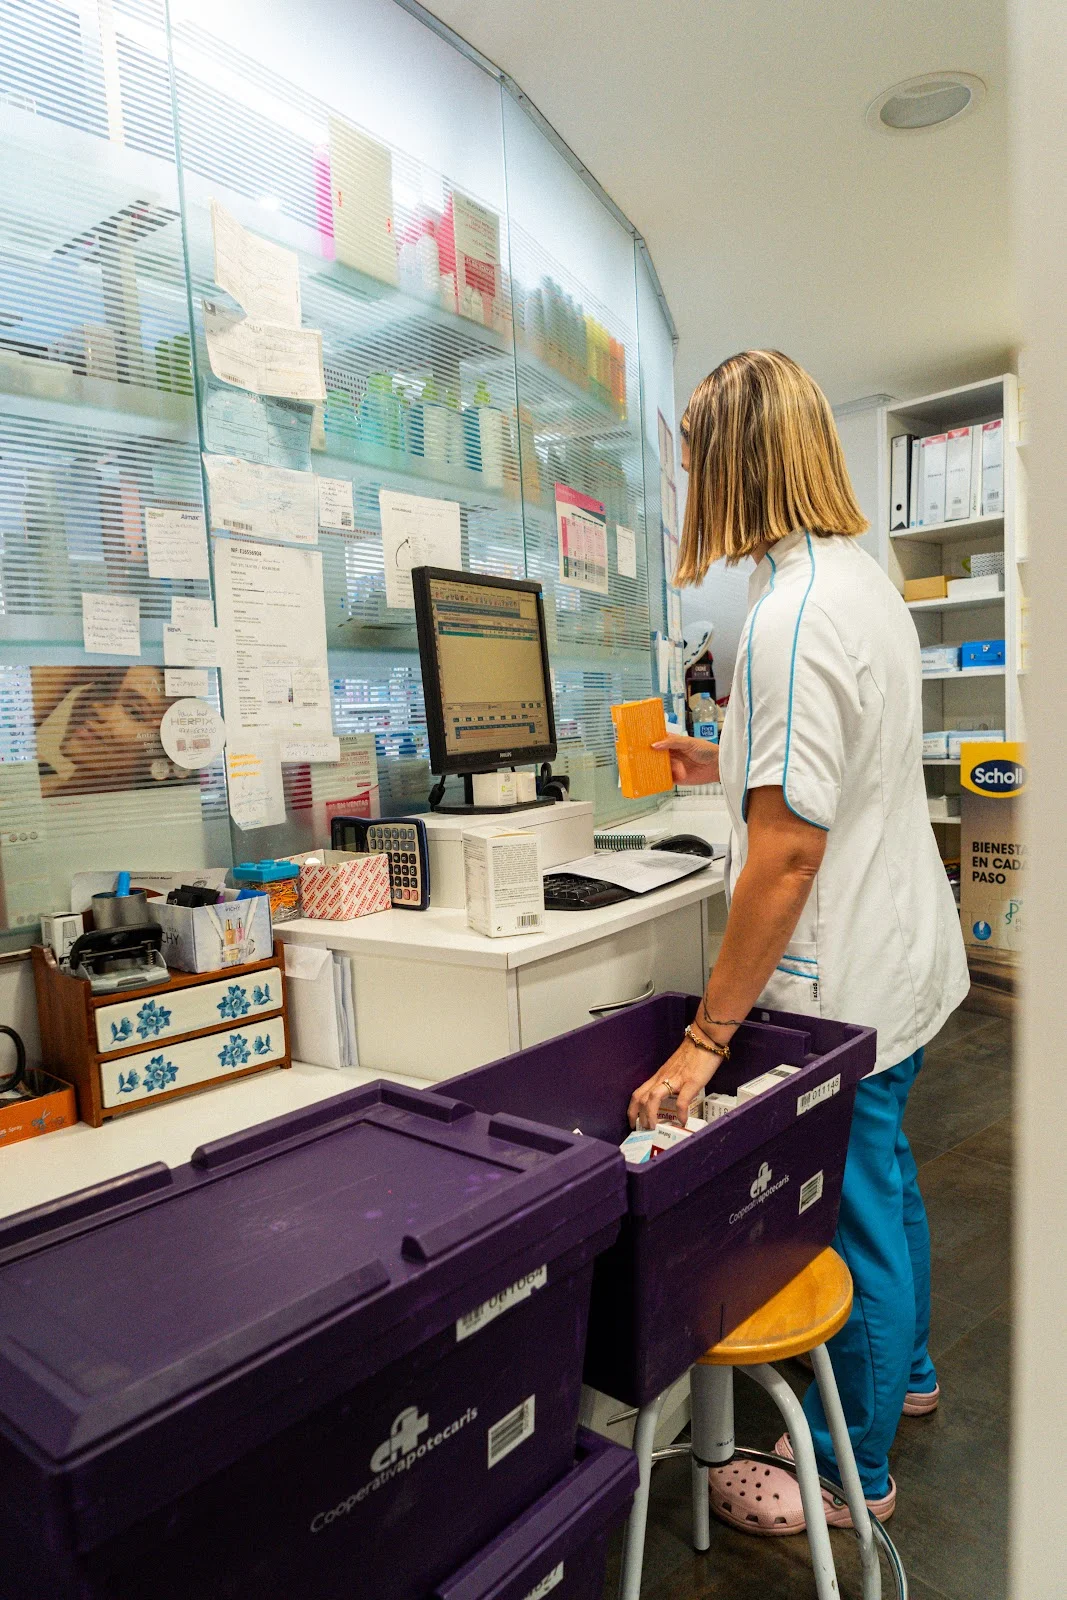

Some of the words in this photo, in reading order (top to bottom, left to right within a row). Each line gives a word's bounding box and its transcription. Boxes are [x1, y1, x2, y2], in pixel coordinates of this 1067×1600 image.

[170, 718, 213, 726] HERPIX
[974, 768, 1023, 784] Scholl
[972, 856, 988, 868] EN
[972, 871, 1006, 884] PASO
[812, 1077, 839, 1100] 011148
